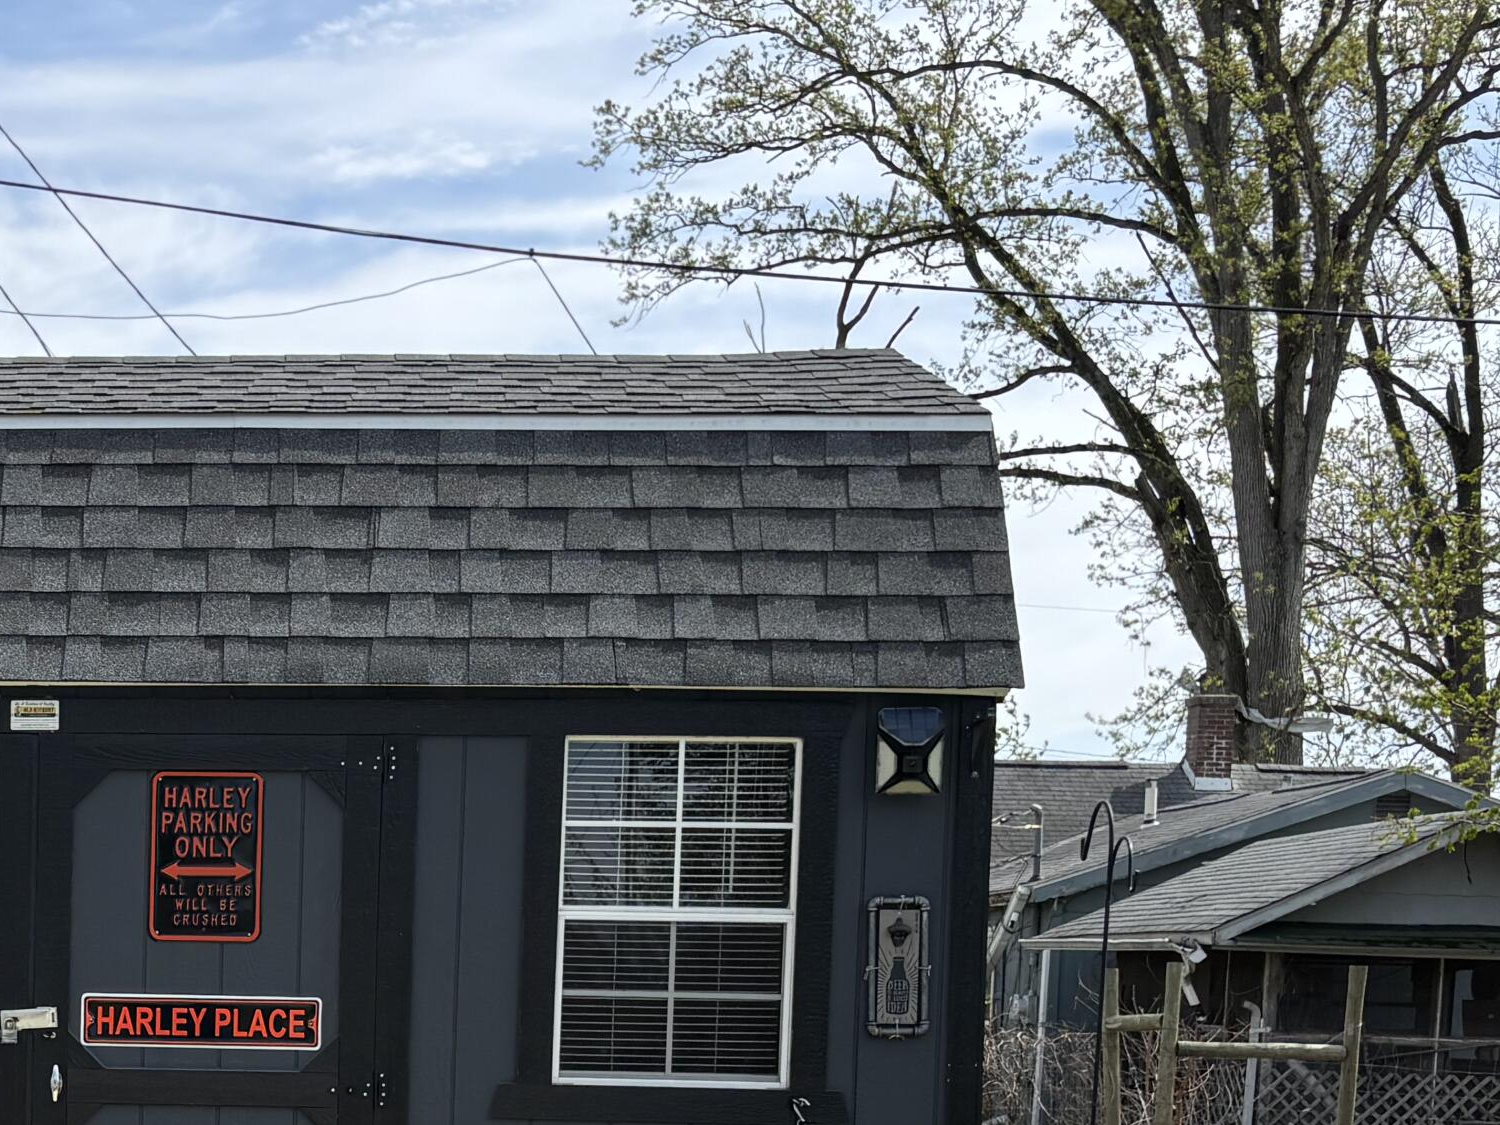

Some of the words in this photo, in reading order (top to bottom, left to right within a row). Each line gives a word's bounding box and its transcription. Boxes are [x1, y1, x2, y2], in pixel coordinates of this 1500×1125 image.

[163, 786, 252, 809] HARLEY
[161, 811, 252, 834] PARKING
[174, 835, 241, 859] ONLY
[159, 883, 186, 896] ALL
[197, 884, 252, 896] OTHERS
[175, 899, 208, 911] WILL
[219, 899, 237, 911] BE
[173, 913, 238, 926] CRUSHED
[97, 1006, 207, 1037] HARLEY
[214, 1008, 306, 1039] PLACE
